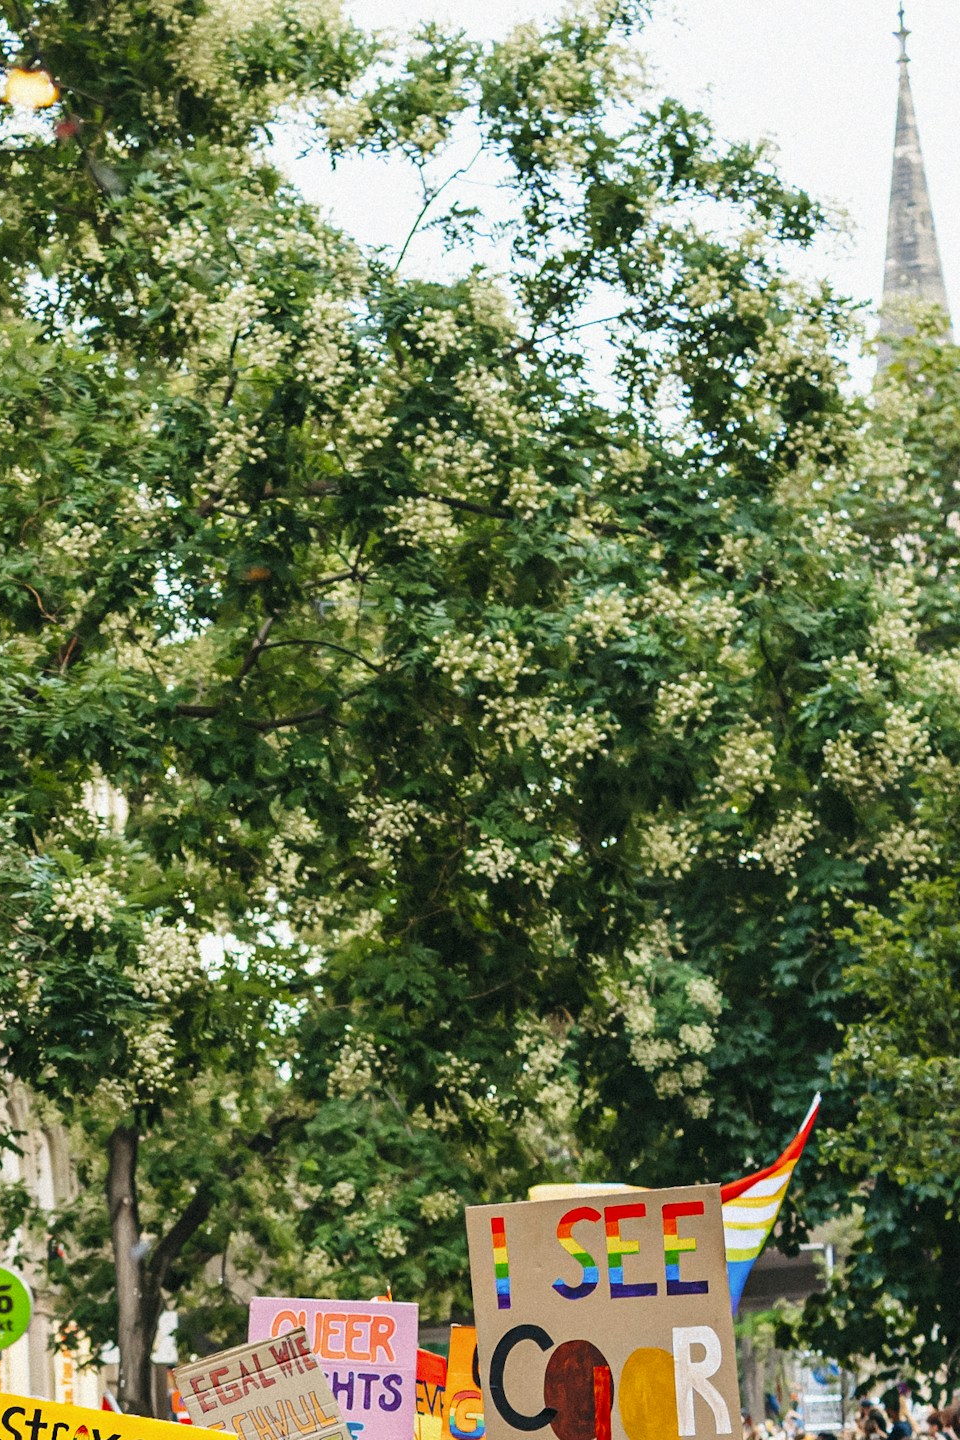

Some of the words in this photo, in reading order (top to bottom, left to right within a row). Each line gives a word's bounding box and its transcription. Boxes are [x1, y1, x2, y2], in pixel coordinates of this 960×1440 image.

[491, 1217, 511, 1310] I
[552, 1201, 709, 1300] SEE
[190, 1353, 276, 1414] EGAL
[332, 1371, 403, 1412] HTS
